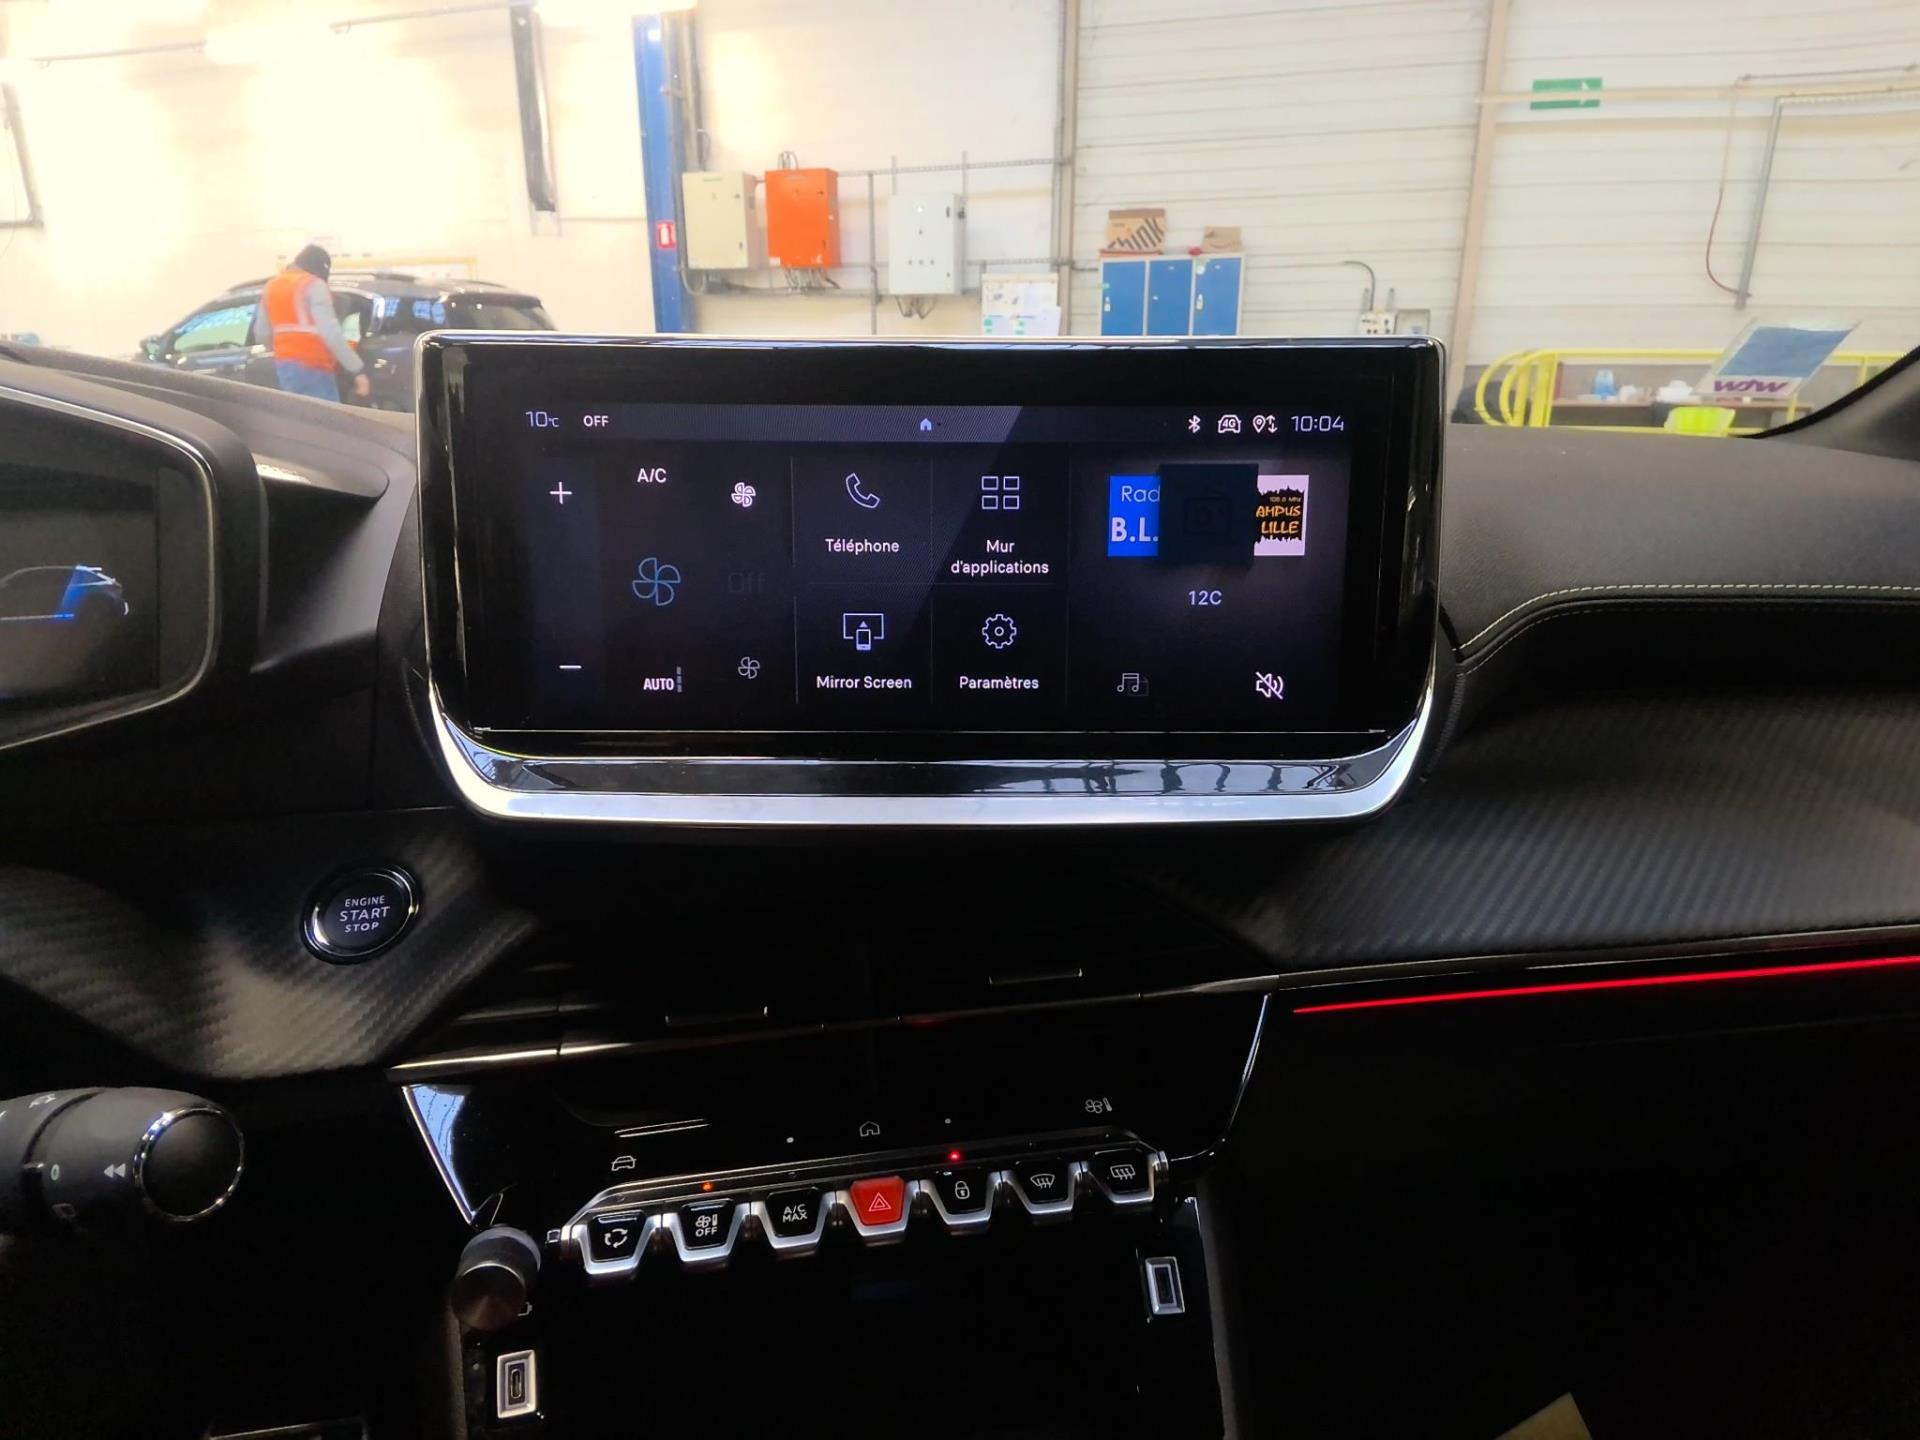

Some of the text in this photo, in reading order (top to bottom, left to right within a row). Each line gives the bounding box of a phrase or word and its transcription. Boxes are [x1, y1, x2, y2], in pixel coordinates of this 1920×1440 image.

[583, 415, 609, 427] OFF
[1291, 415, 1344, 432] 10:04
[637, 468, 667, 484] A/C
[1261, 520, 1299, 534] LILLE
[825, 538, 900, 556] Téléphone
[986, 540, 1015, 553] Mur
[950, 559, 1049, 577] d'applications
[1188, 590, 1222, 606] 12C
[643, 677, 675, 691] AUTO
[816, 675, 912, 689] Mirror Screen
[959, 675, 1039, 690] Paramètres
[344, 895, 385, 907] ENGINE
[339, 906, 390, 921] START
[345, 922, 379, 933] STOP
[783, 1203, 806, 1215] A/C
[782, 1211, 808, 1222] MAX
[695, 1226, 718, 1237] OFF
